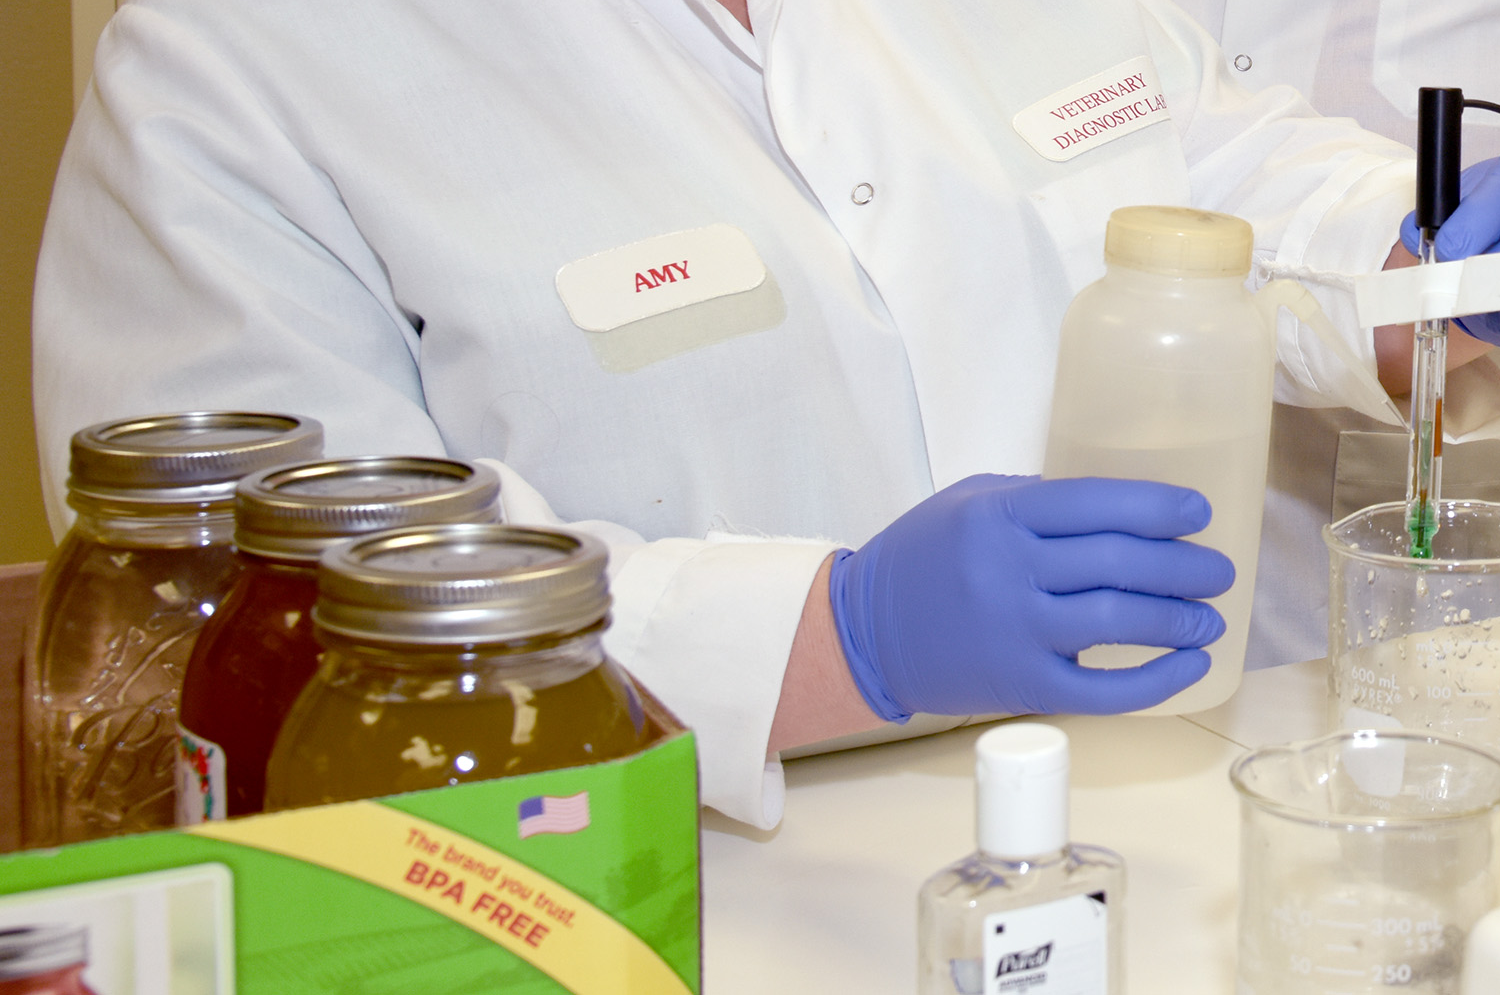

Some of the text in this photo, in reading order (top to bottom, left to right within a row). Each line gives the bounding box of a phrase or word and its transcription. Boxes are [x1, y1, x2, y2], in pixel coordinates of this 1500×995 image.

[1050, 73, 1147, 121] VETERINARY
[1052, 101, 1148, 150] DIAGNOSTIC
[633, 260, 691, 293] AMY
[1351, 666, 1400, 691] 600 mL
[1427, 685, 1452, 700] 100
[404, 827, 440, 855] The
[442, 844, 500, 882] brand
[498, 875, 533, 901] you
[404, 860, 551, 948] BPA FREE
[1371, 917, 1412, 937] 300
[1415, 912, 1444, 935] mL
[1371, 964, 1412, 984] 250
